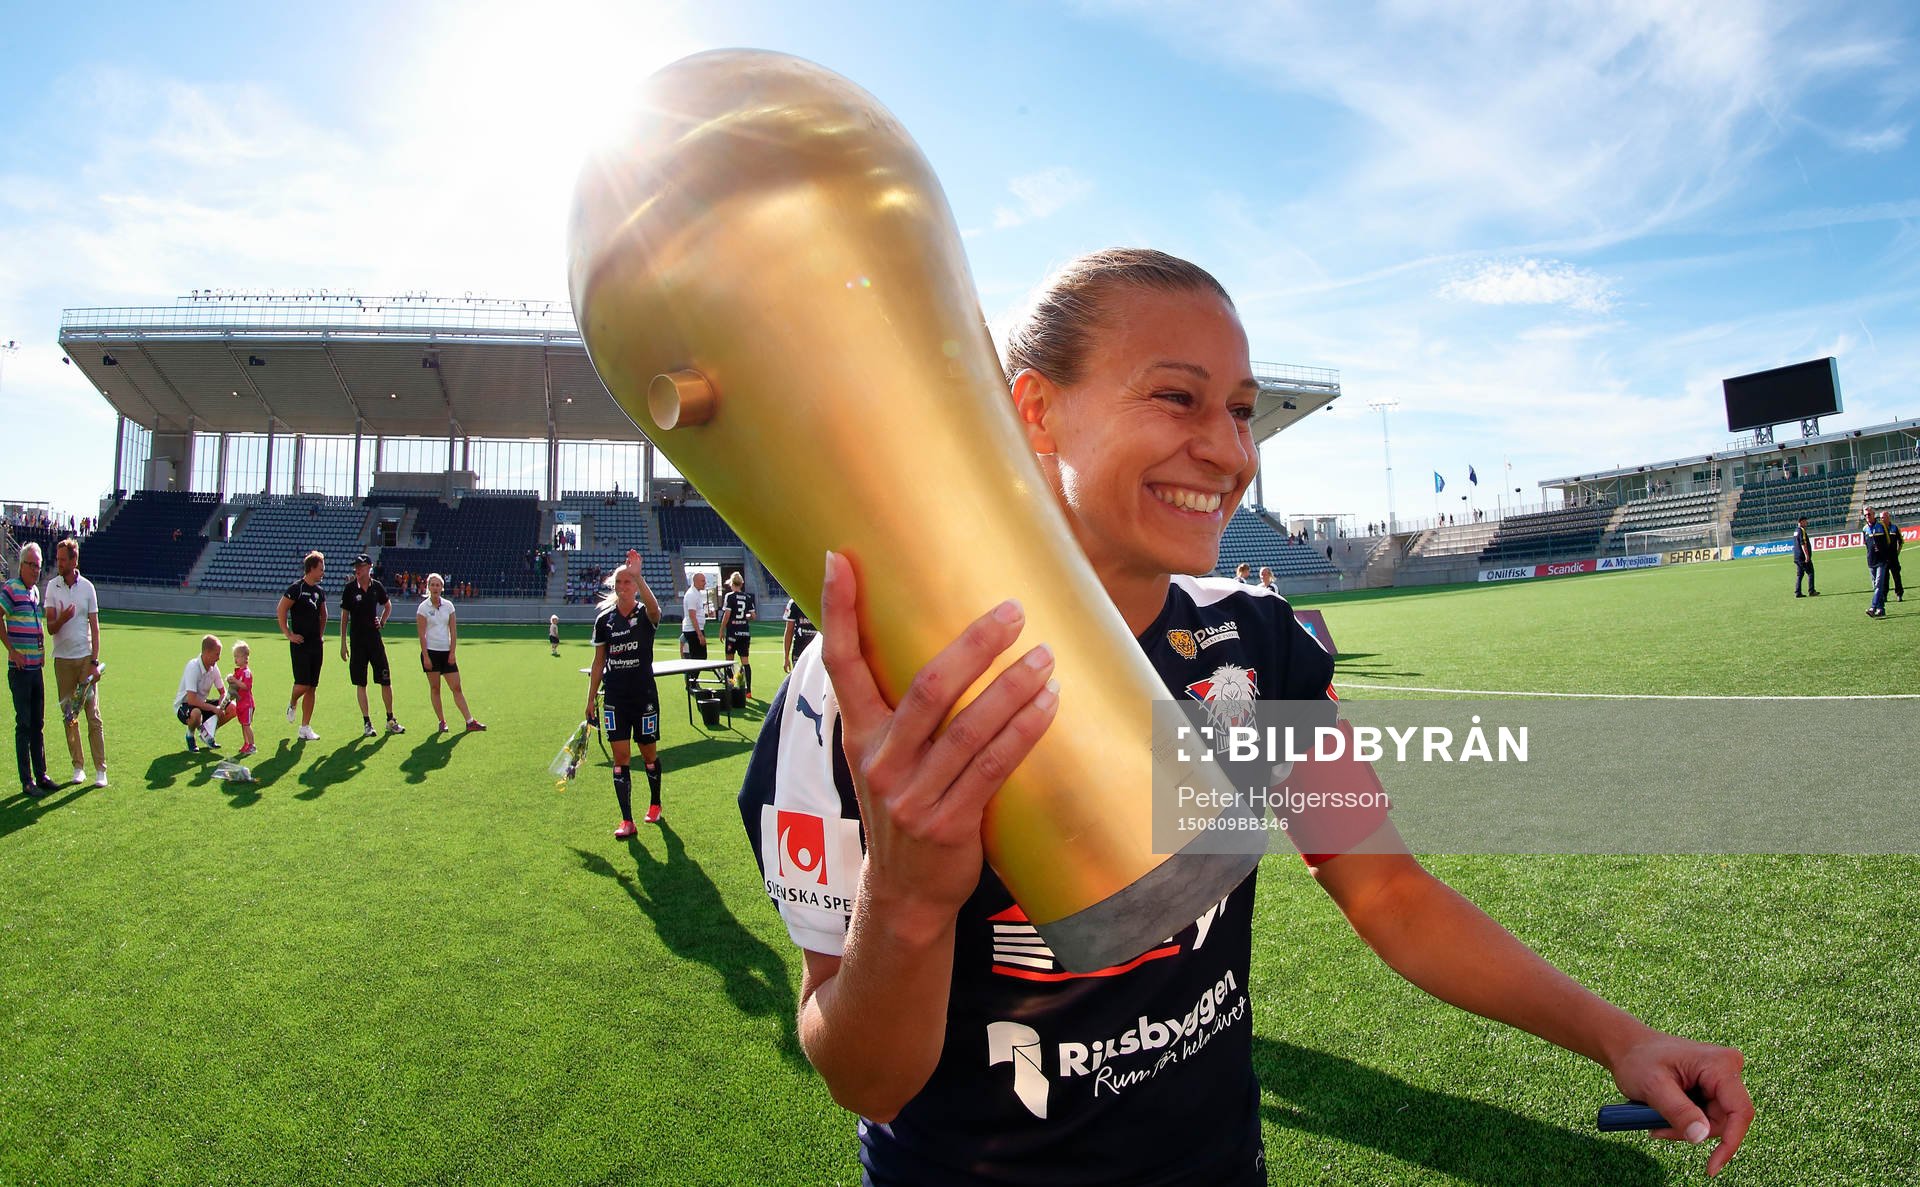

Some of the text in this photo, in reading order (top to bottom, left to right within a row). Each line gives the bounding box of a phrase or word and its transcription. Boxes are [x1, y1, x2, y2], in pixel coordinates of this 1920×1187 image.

[1495, 568, 1527, 579] Nilfisk
[1547, 562, 1584, 575] Scandic
[735, 601, 746, 619] 3
[766, 880, 853, 912] SVENSKA SPE
[1059, 969, 1237, 1077] Riksbyggen
[1094, 1066, 1151, 1097] Rum
